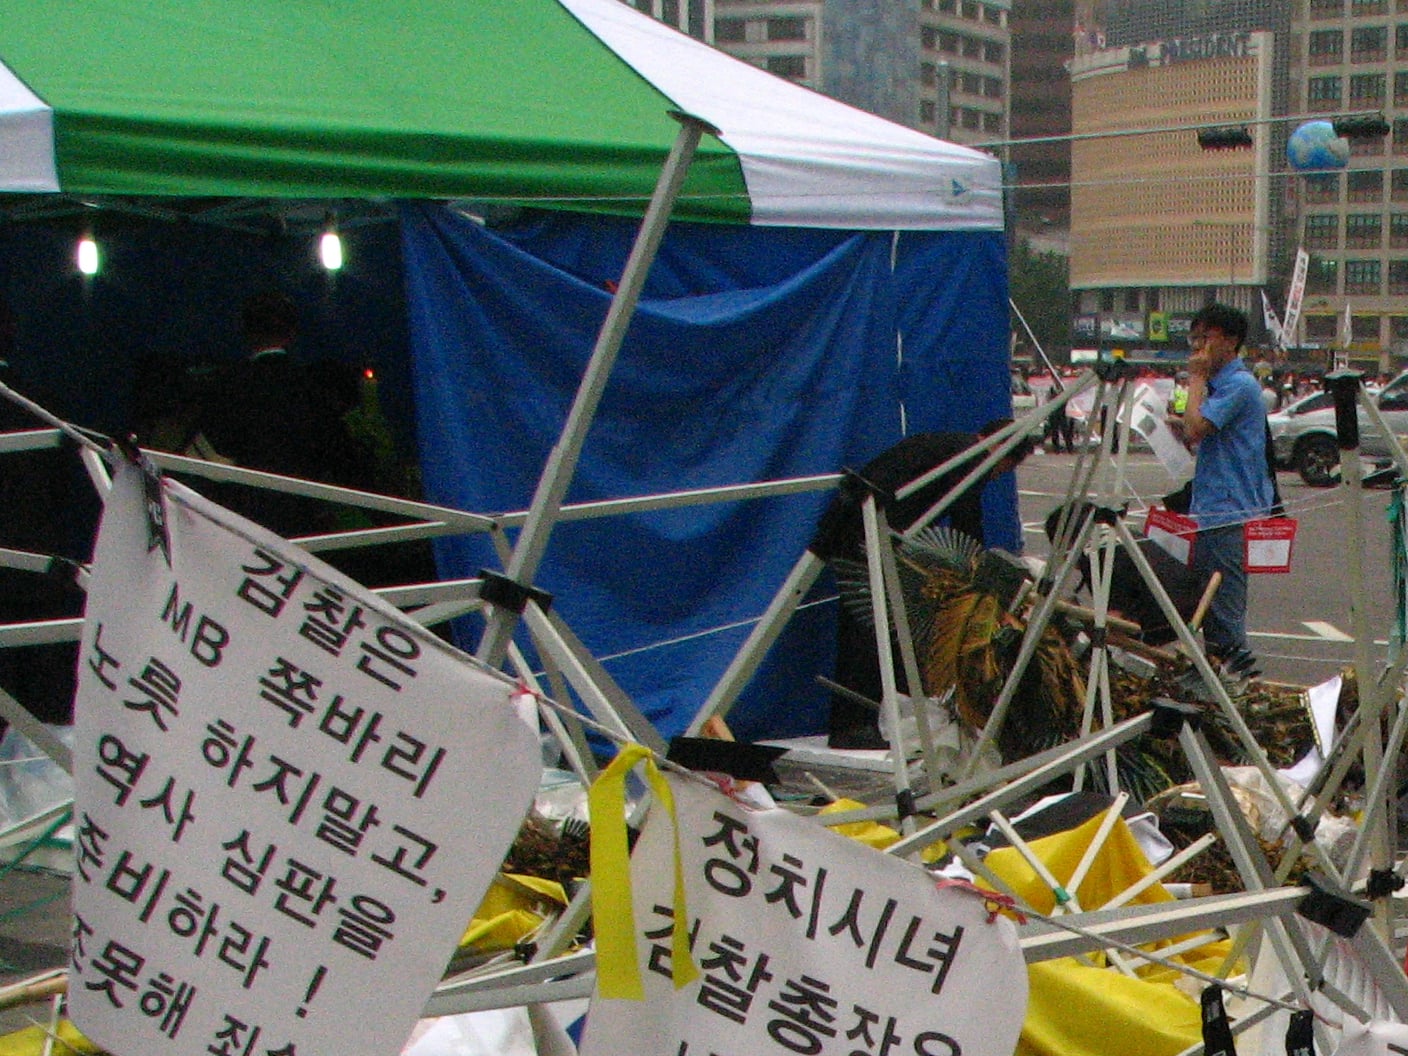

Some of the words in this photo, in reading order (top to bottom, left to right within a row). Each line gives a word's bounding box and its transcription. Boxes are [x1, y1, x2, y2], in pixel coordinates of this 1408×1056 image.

[90, 624, 181, 731] 노릇
[161, 581, 231, 666] MB
[259, 656, 447, 799] 쪽바리
[236, 549, 425, 692] 검찰은
[97, 734, 197, 842] 역사
[220, 830, 397, 960] 심판을
[702, 810, 966, 996] 정치시녀
